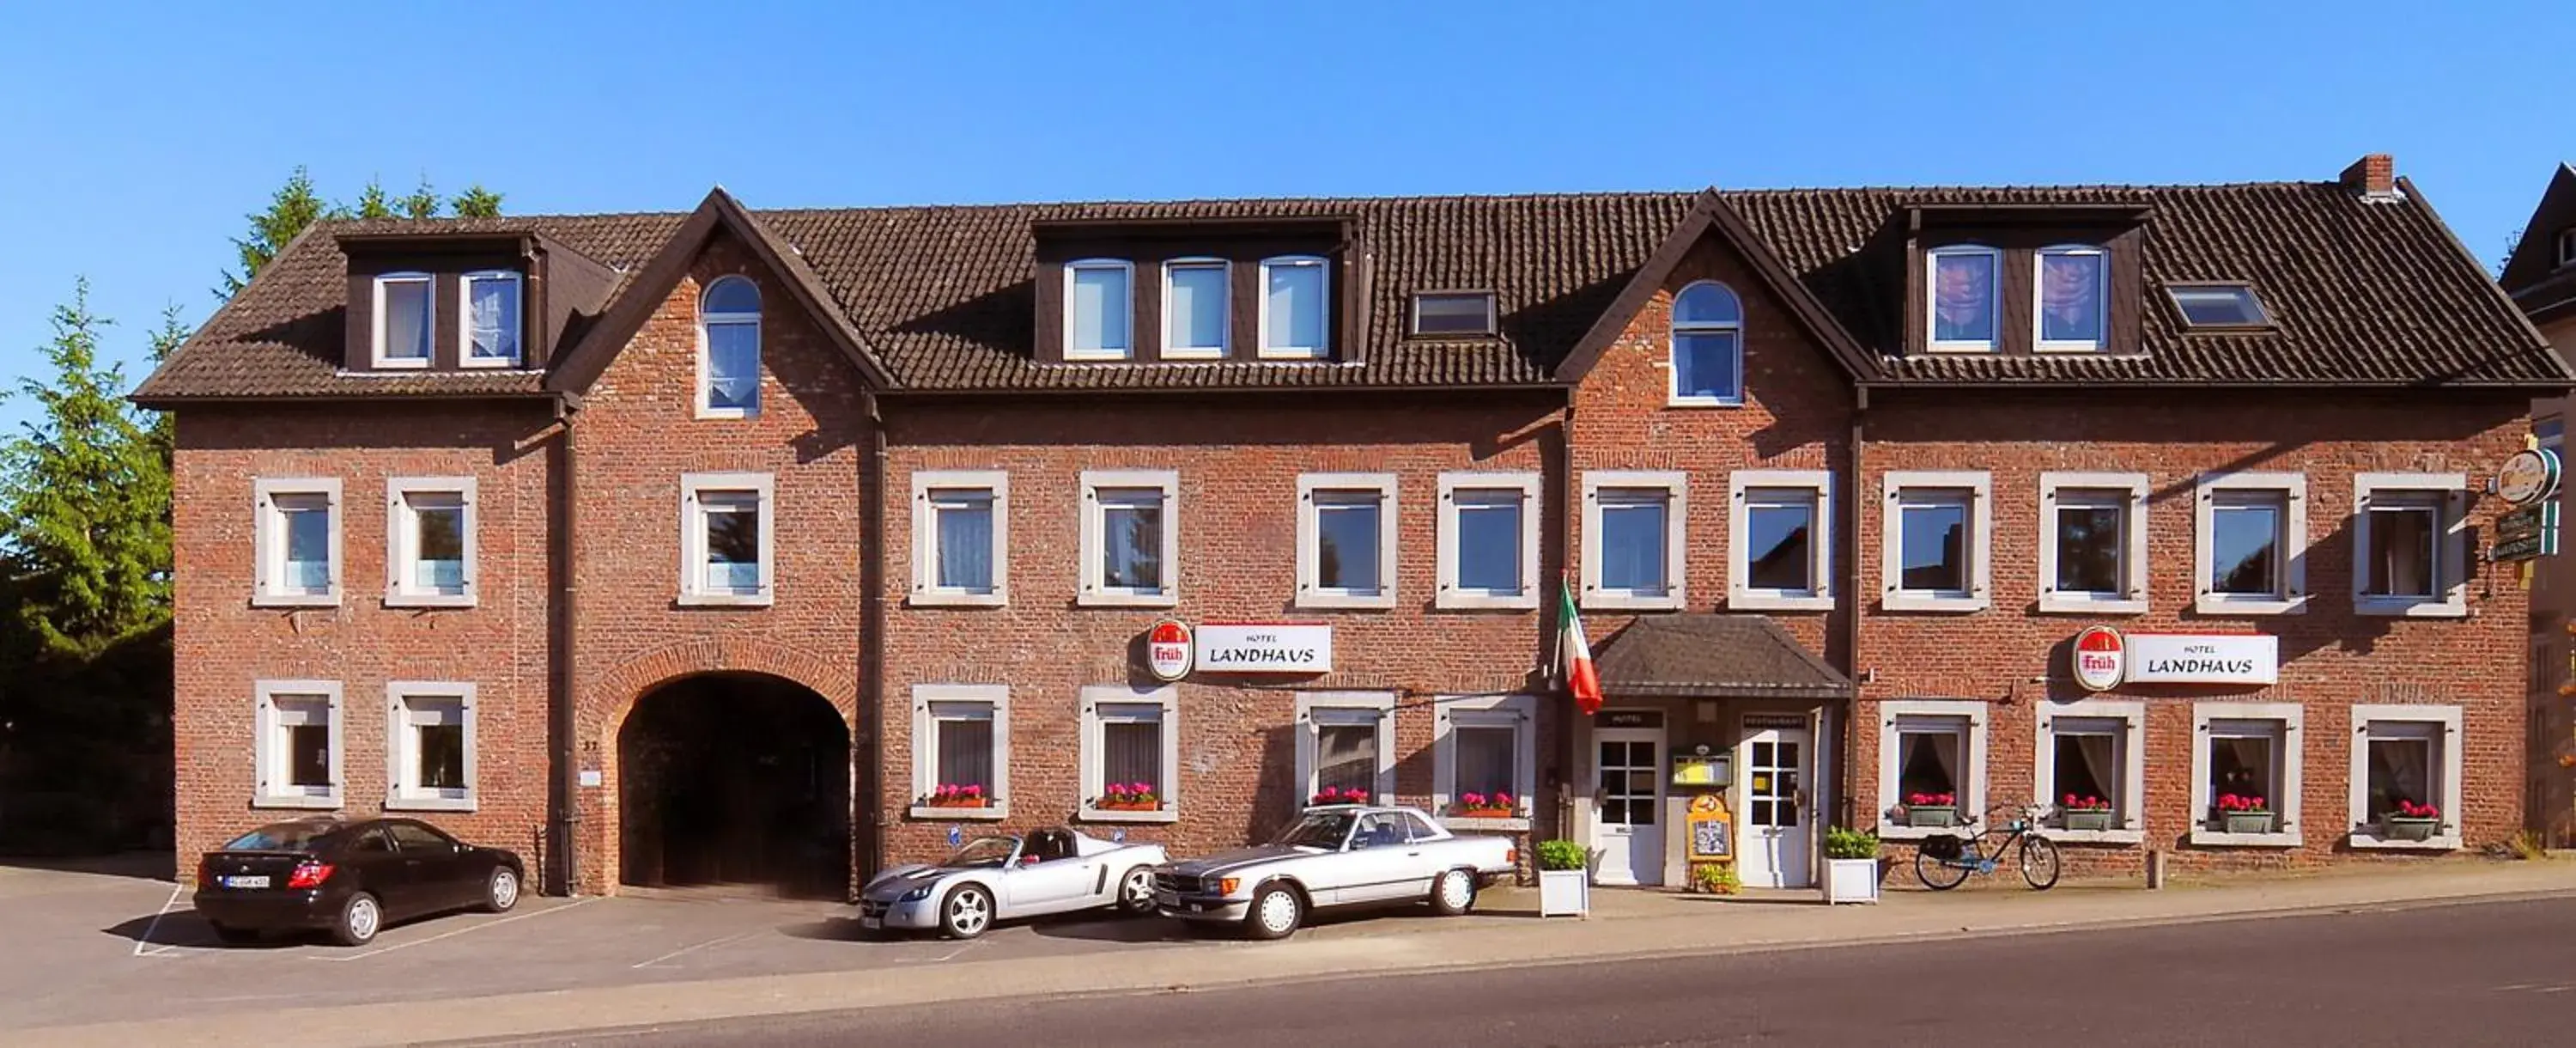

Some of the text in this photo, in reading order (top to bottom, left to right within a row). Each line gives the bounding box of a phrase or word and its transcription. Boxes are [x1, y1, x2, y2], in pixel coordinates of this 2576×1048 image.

[1155, 646, 1182, 661] Früh
[1210, 649, 1315, 662] LANDHAUS
[2184, 645, 2216, 654] HOTEL
[2084, 655, 2115, 670] Früh
[2148, 659, 2253, 673] LANDHAUS
